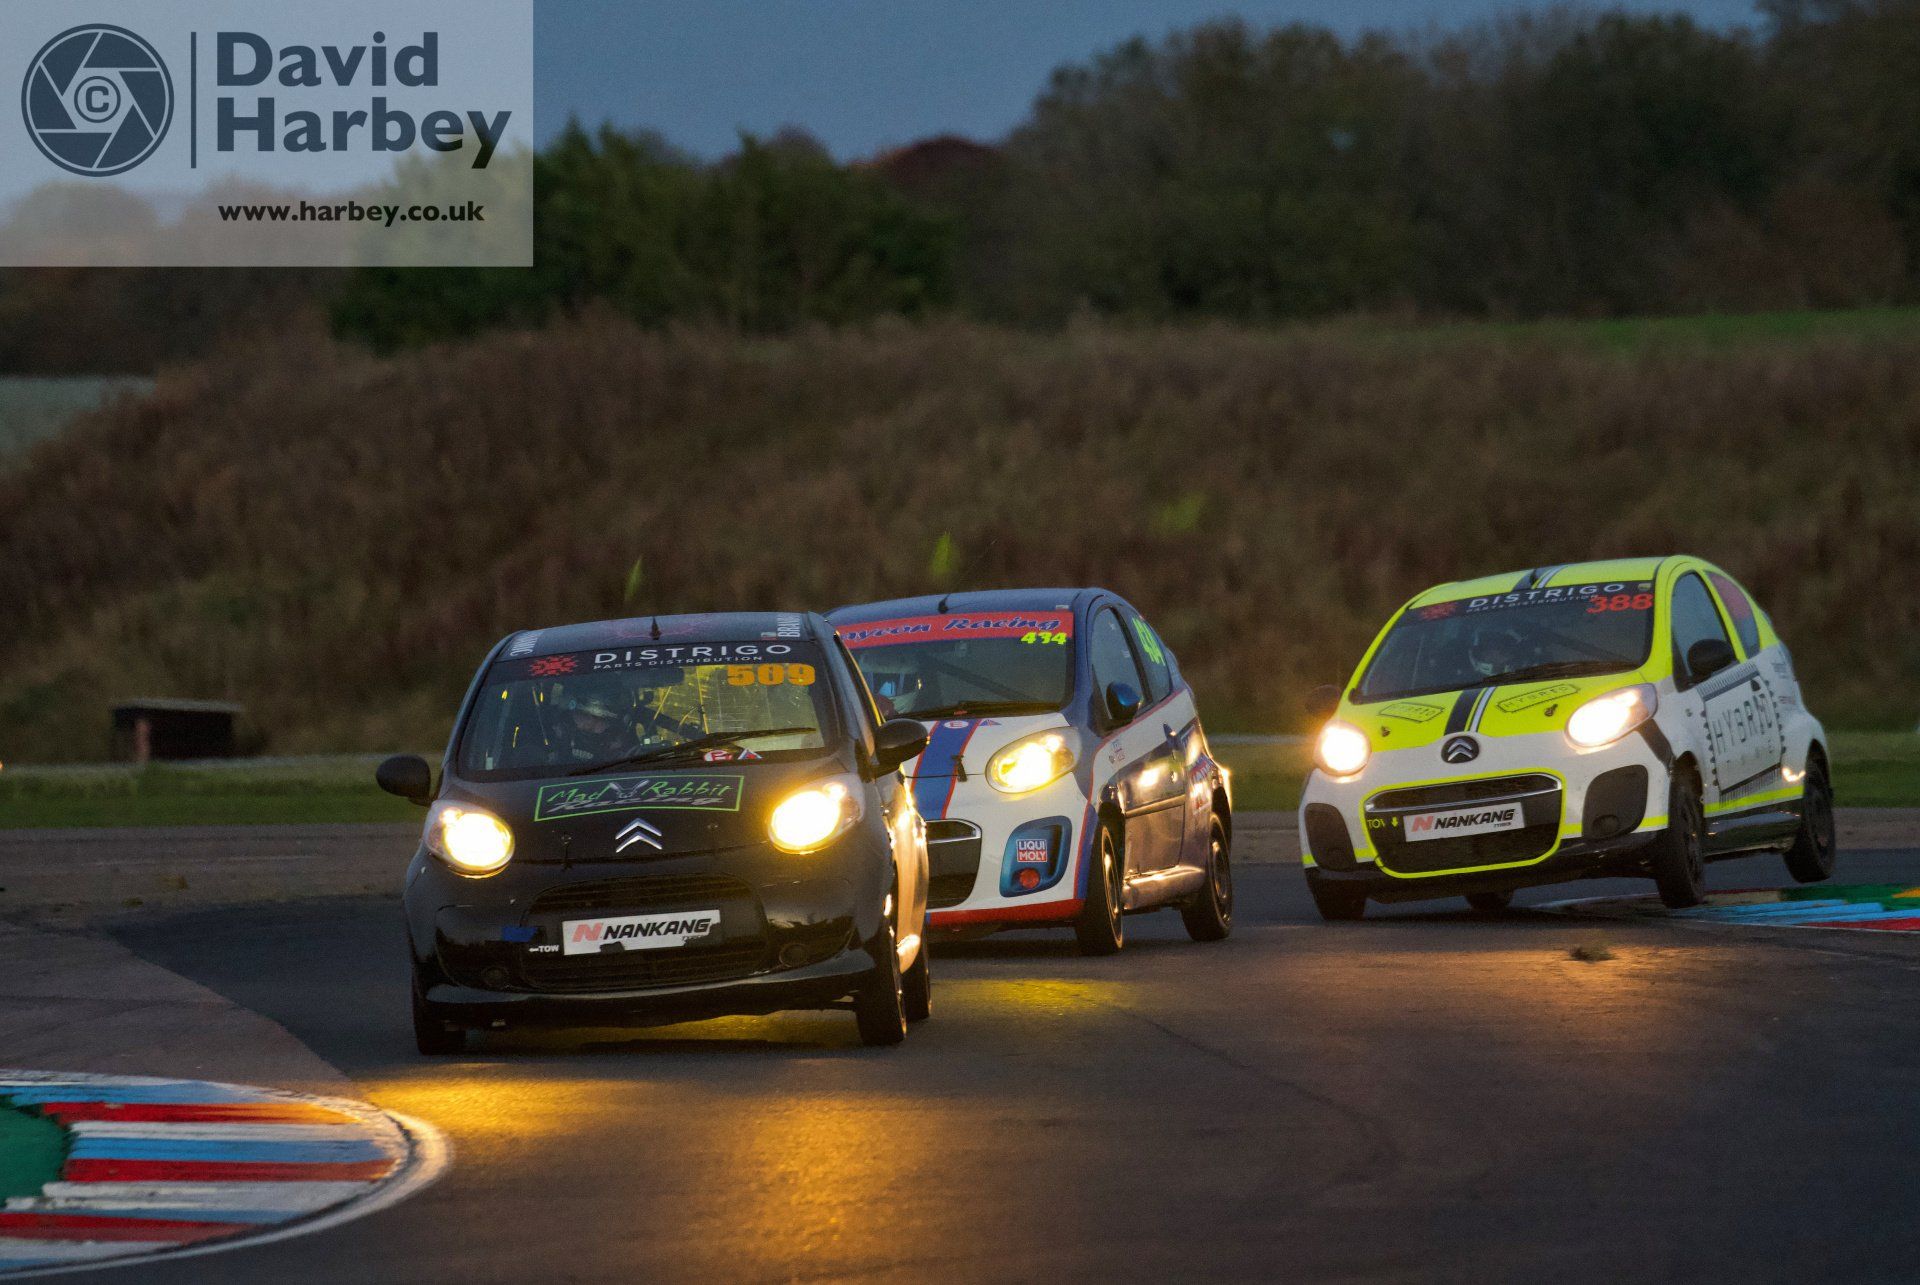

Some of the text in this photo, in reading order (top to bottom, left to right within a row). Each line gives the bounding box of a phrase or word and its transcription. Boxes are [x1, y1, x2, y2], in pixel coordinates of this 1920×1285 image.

[1469, 584, 1625, 608] DISTRIGO
[1586, 593, 1654, 615] 388
[943, 616, 1061, 631] Racing
[593, 656, 763, 670] PARTS DISTRIBUTION
[594, 644, 792, 664] DISTRIGO
[727, 663, 816, 686] 509
[547, 781, 734, 803] Mad Rabbit
[1434, 808, 1516, 830] NANKANG
[1018, 840, 1046, 850] LIQUI
[1018, 851, 1046, 861] MOLY
[603, 918, 712, 940] NANKANG
[539, 945, 559, 953] TOW
